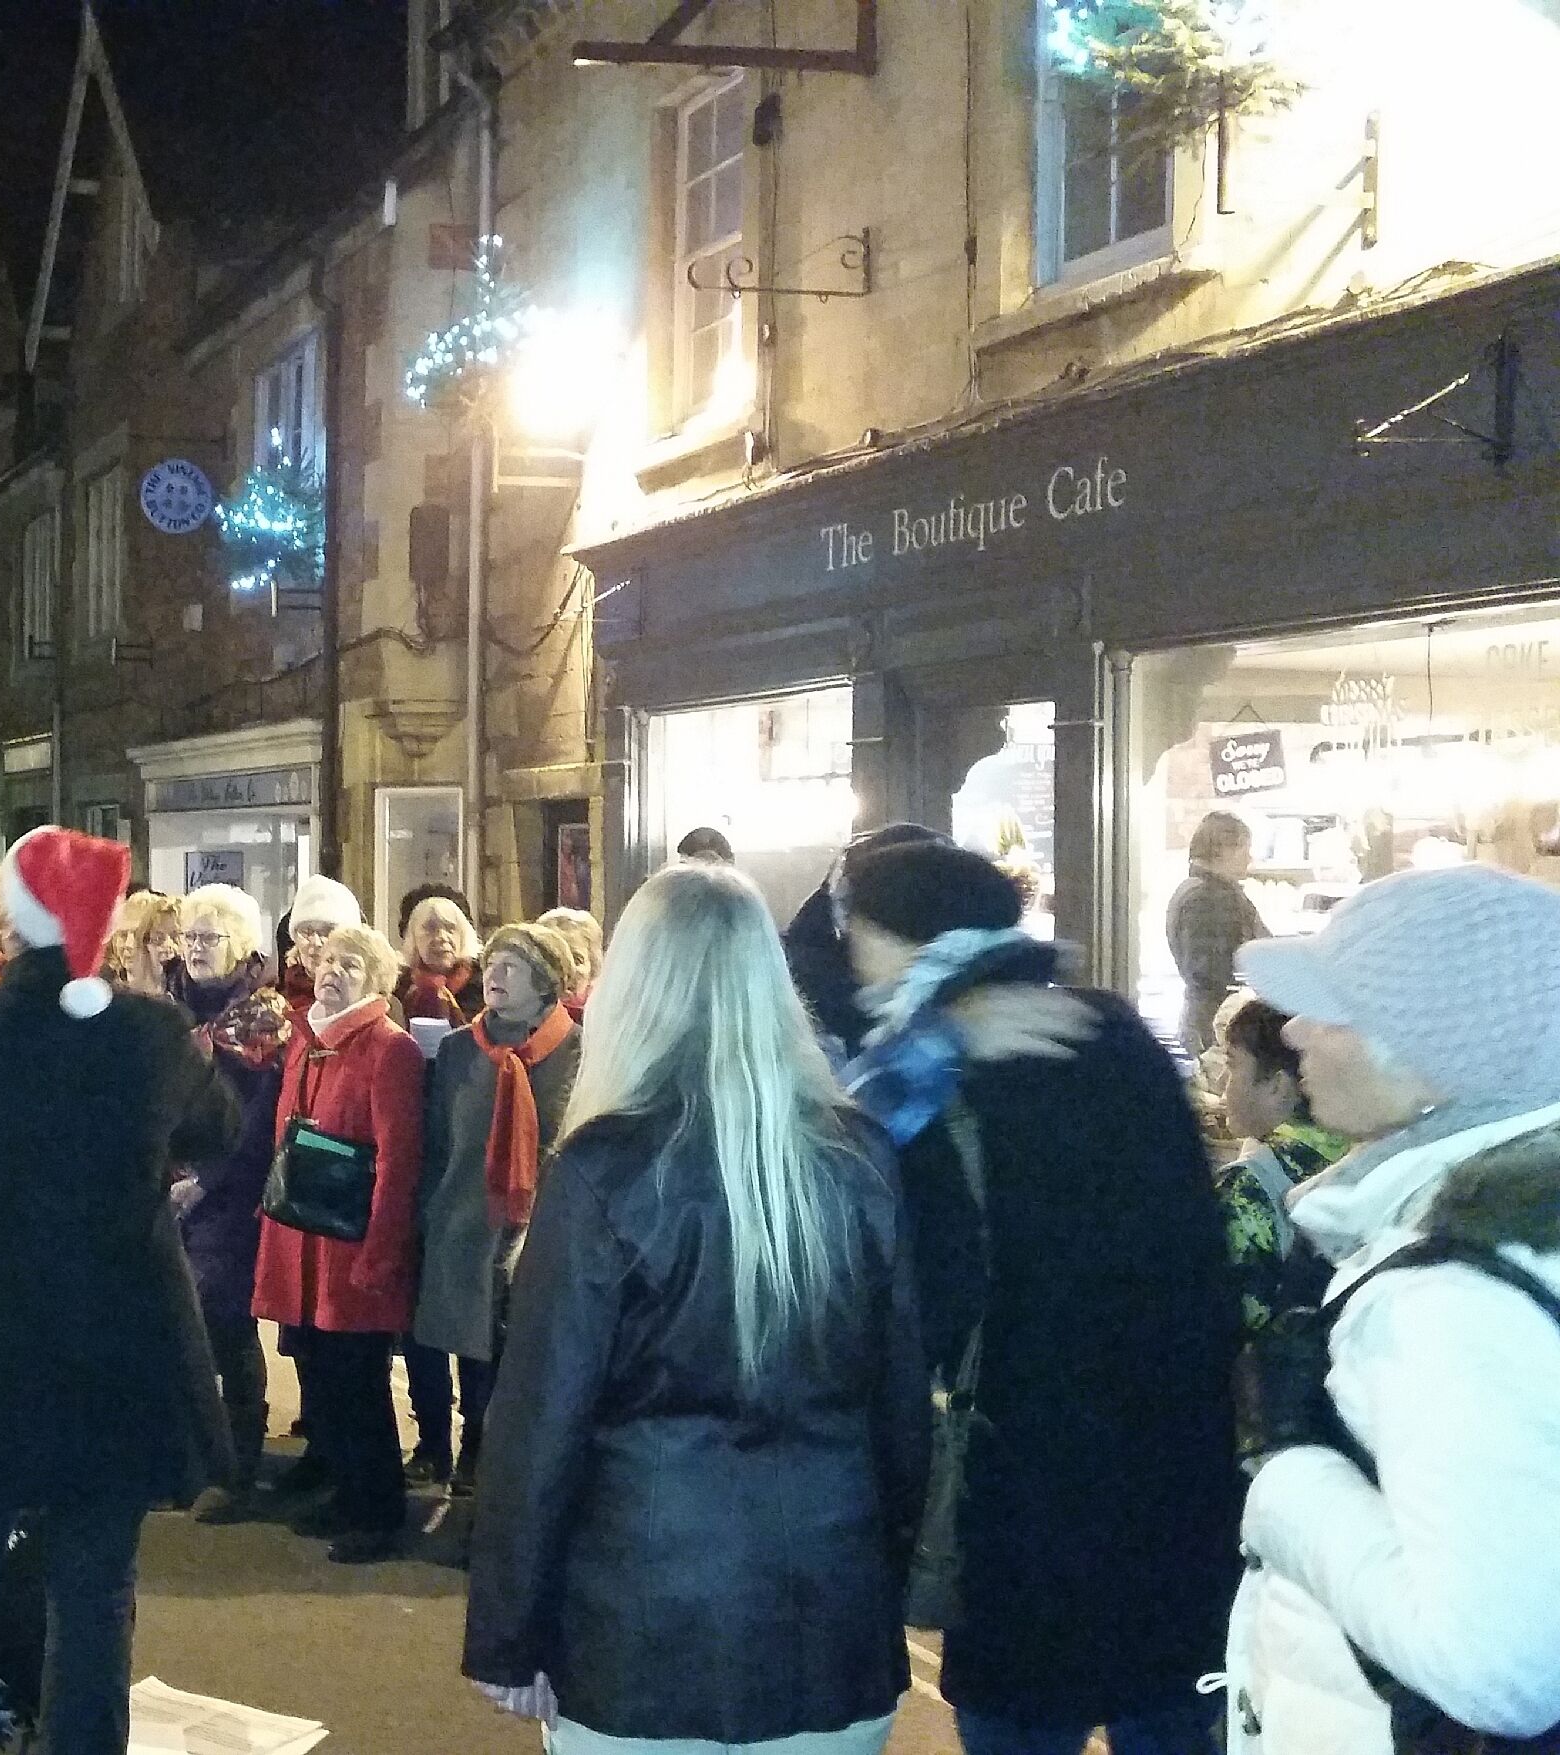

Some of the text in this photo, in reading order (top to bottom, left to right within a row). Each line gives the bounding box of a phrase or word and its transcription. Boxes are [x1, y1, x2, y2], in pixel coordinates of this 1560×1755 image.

[819, 456, 1127, 571] The Boutique Cafe
